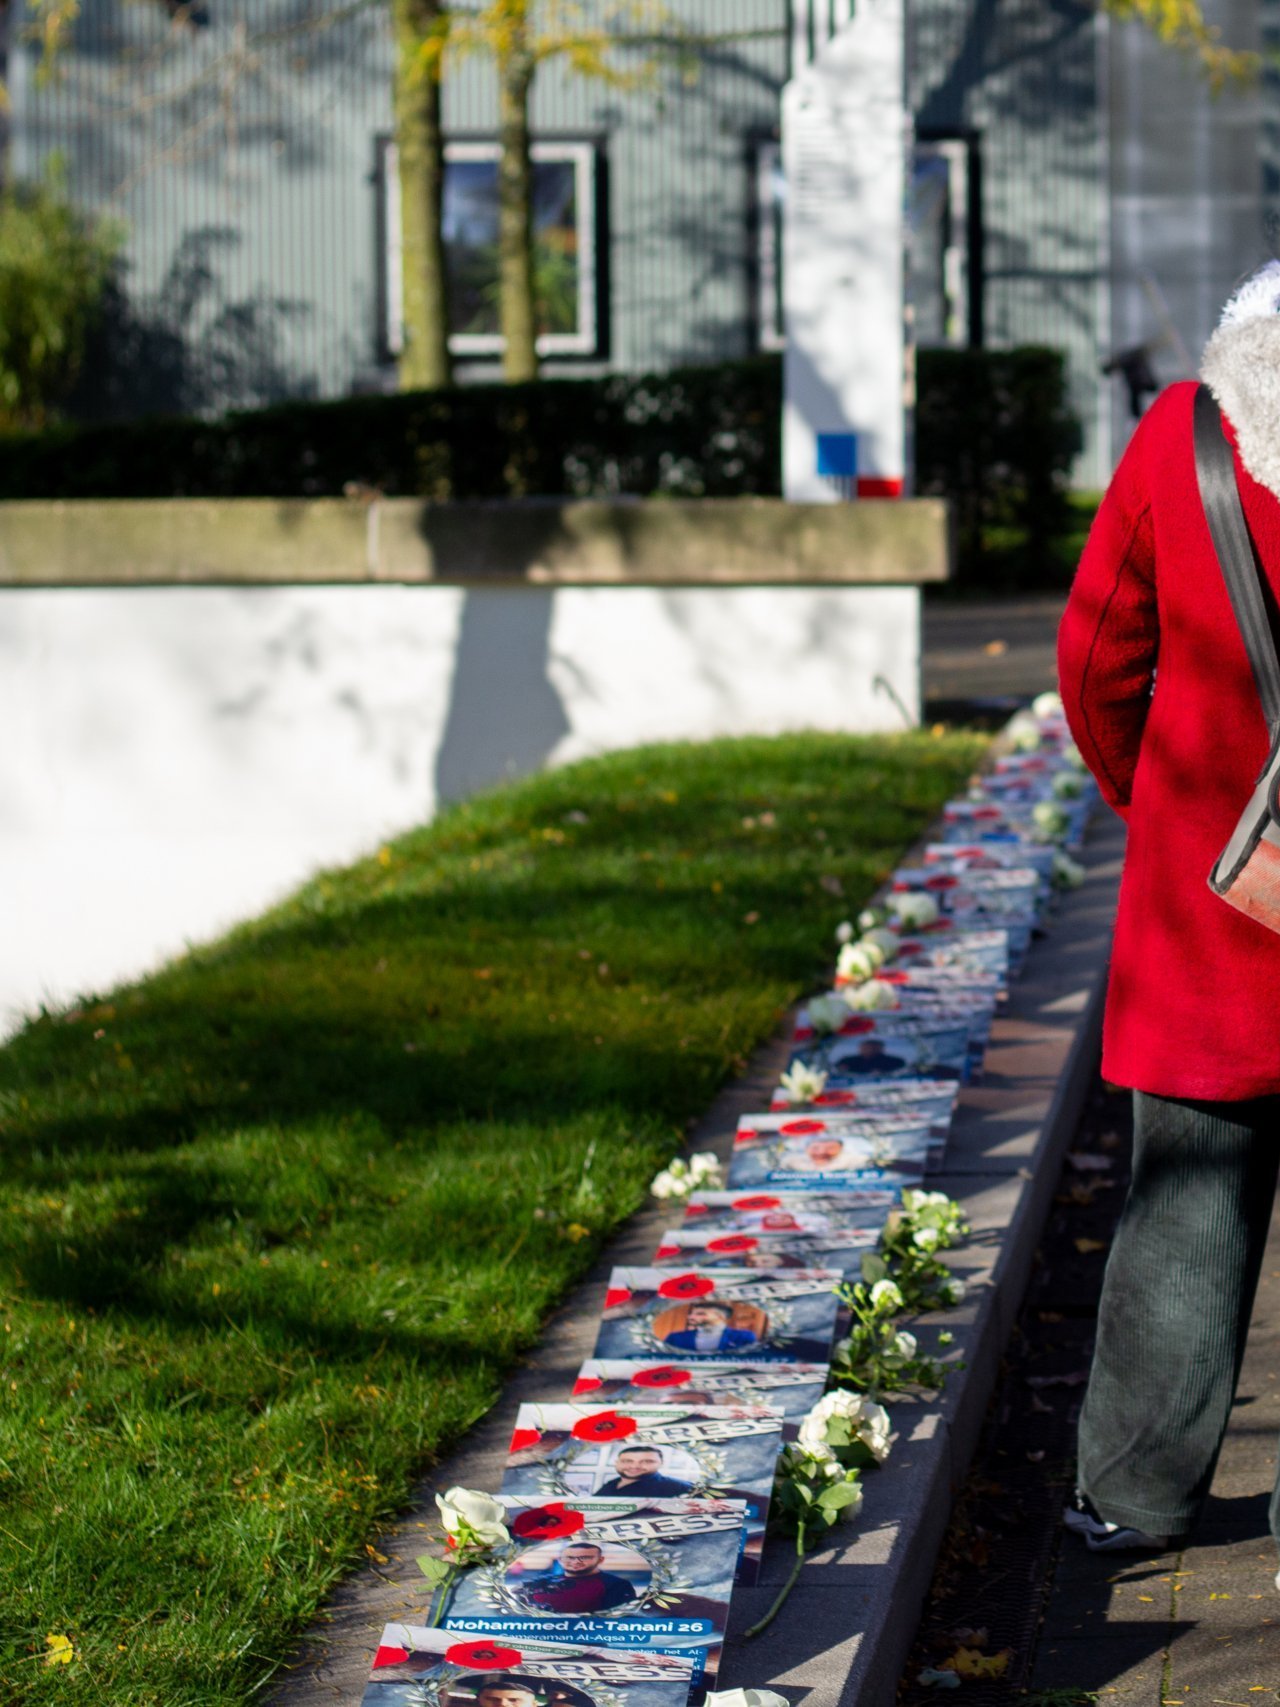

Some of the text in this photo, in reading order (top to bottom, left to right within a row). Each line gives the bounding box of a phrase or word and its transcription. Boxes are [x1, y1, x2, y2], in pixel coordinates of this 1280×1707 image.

[640, 1418, 782, 1441] PRESS
[587, 1511, 743, 1540] PRESS
[446, 1619, 704, 1633] Mohammed Al-Tanani 26
[576, 1633, 626, 1644] Al-Aqsa
[628, 1634, 647, 1643] TV
[512, 1643, 551, 1653] oktober
[519, 1663, 691, 1679] PRESS
